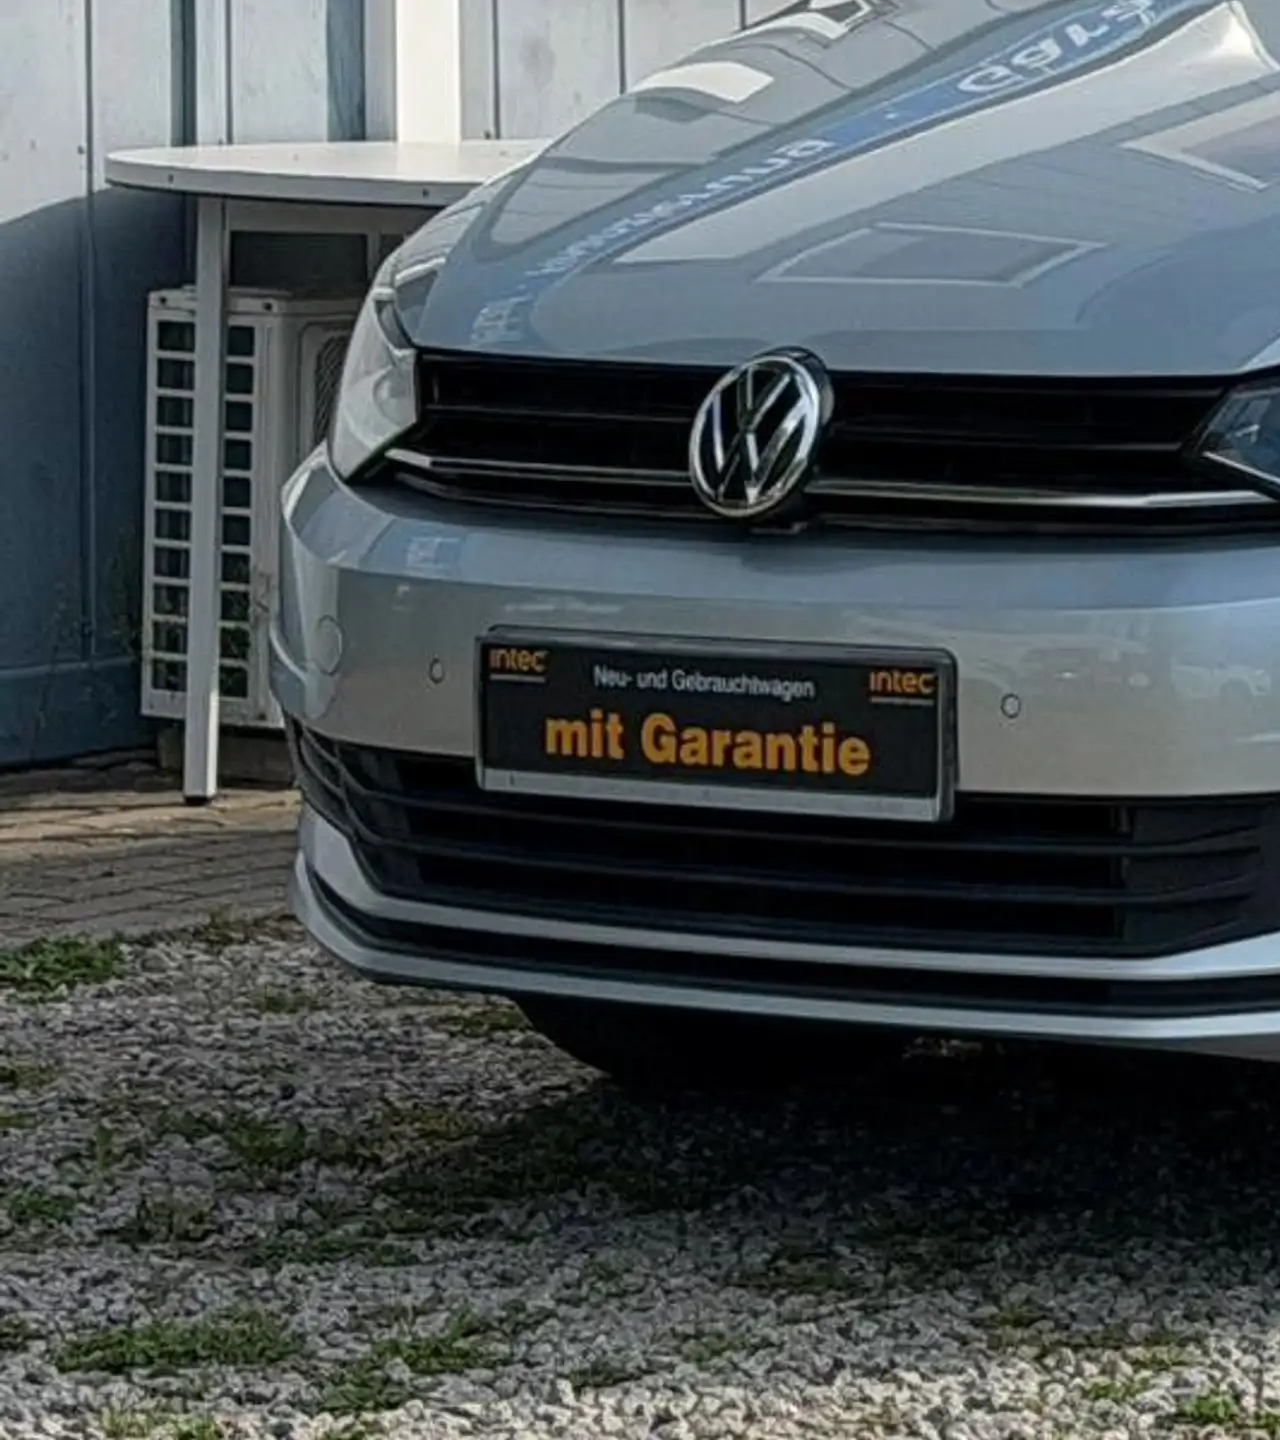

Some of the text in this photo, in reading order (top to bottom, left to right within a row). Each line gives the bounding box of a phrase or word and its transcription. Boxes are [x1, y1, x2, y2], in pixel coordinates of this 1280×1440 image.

[489, 647, 548, 673] intec
[593, 664, 816, 703] Neu- und Gebrauchtwagen
[869, 669, 936, 695] intec
[545, 708, 871, 777] mit Garantie
